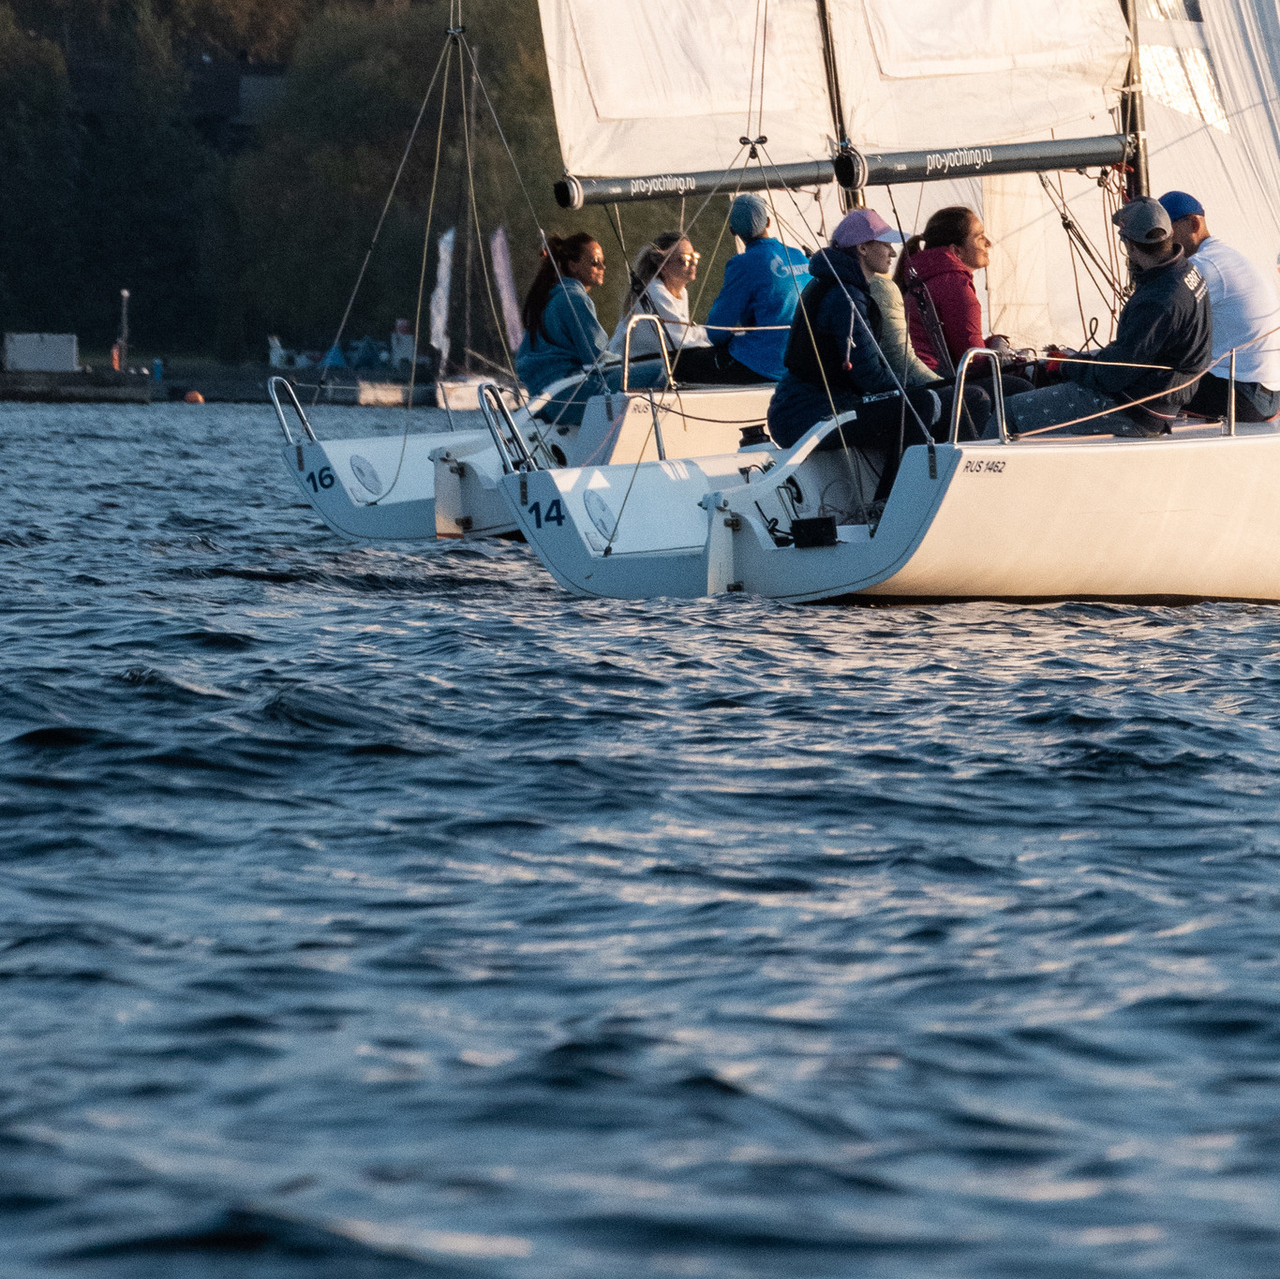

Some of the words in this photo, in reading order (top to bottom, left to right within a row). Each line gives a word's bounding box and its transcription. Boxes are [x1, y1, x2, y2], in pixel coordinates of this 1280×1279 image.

[926, 146, 993, 176] pro-yachting.ru
[630, 174, 697, 197] pro-yachting.ru
[963, 460, 984, 473] RUS
[306, 467, 335, 493] 16
[528, 499, 566, 529] 14
